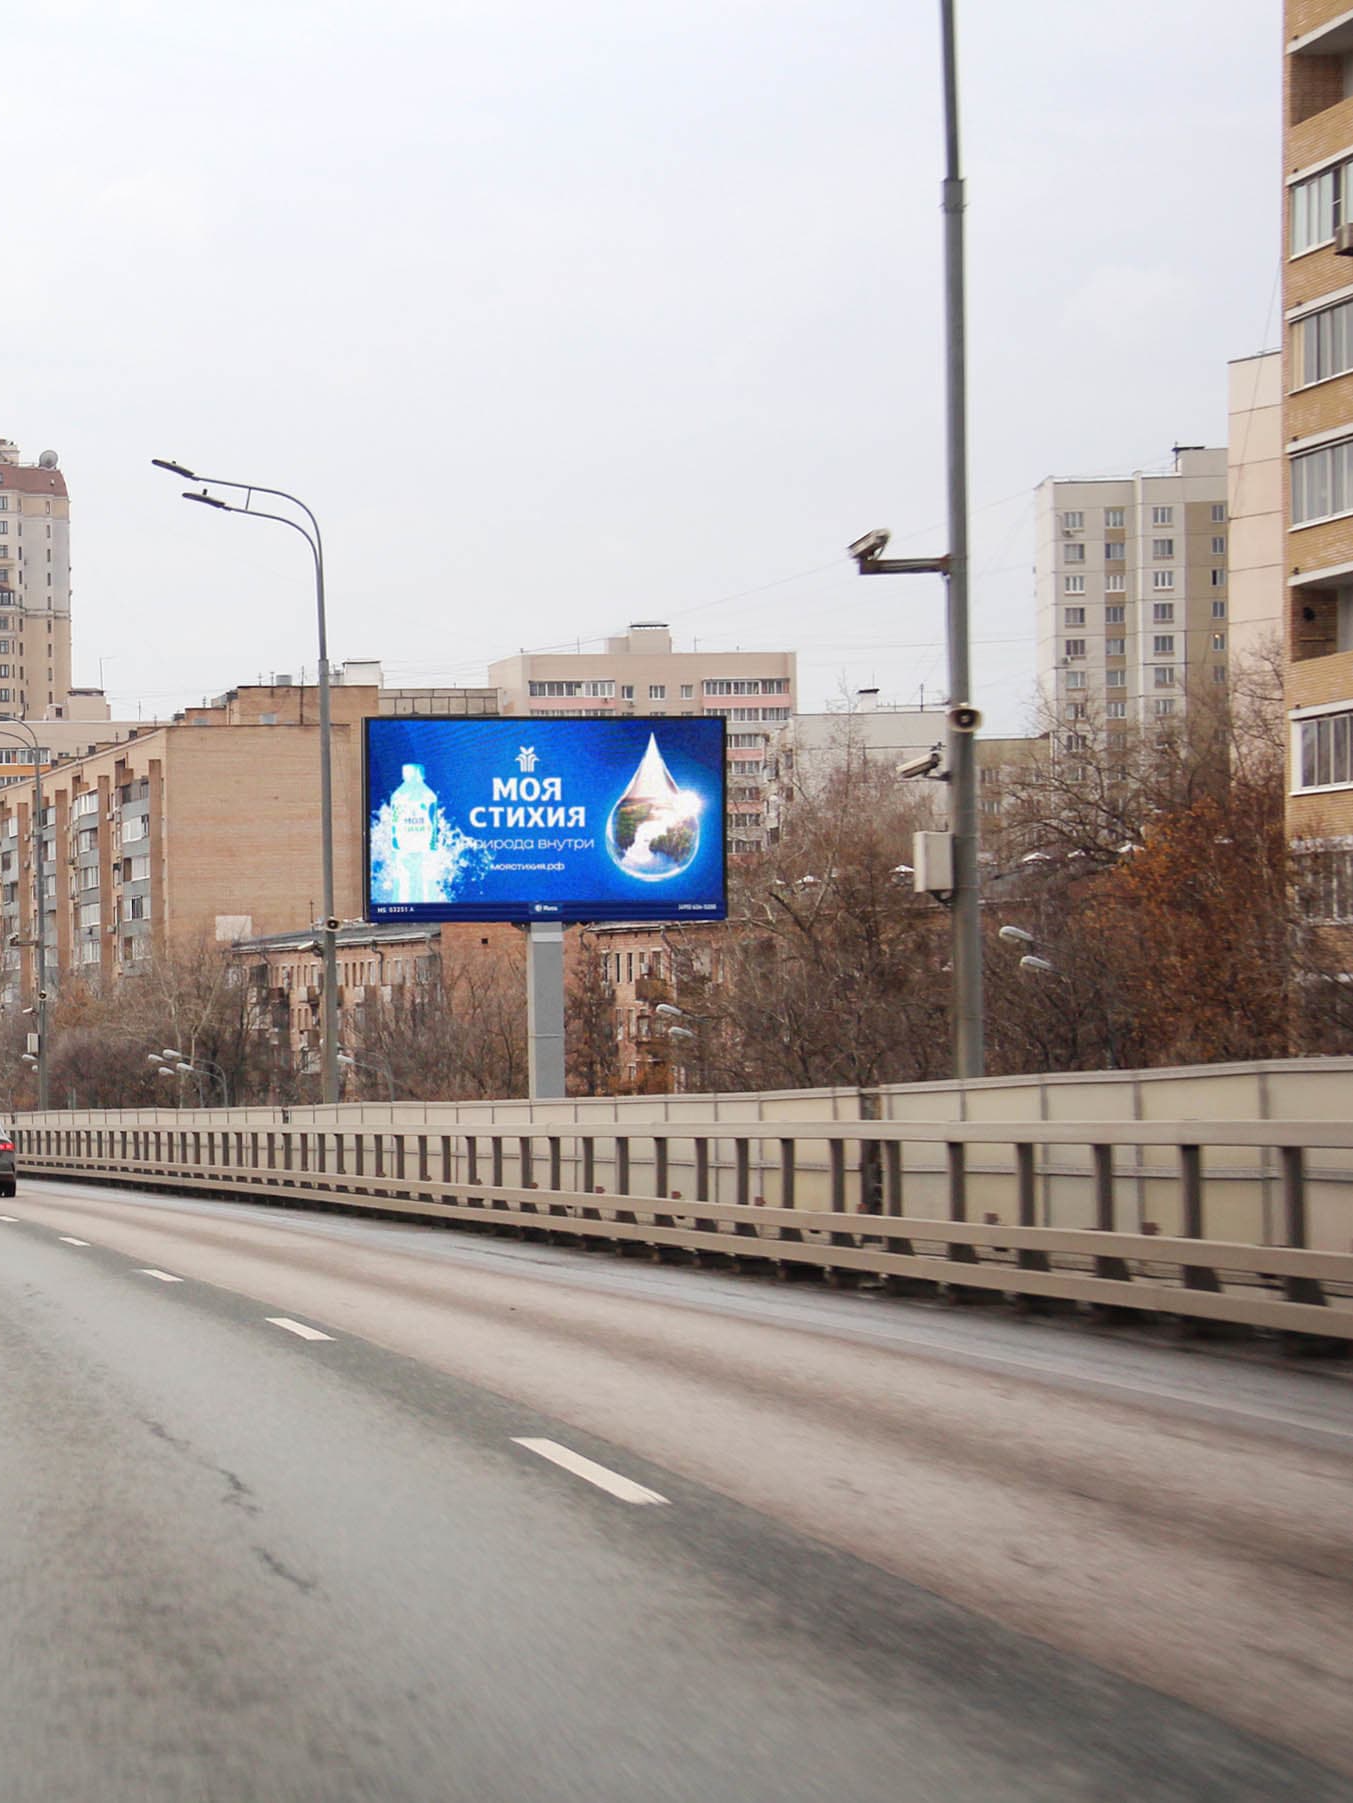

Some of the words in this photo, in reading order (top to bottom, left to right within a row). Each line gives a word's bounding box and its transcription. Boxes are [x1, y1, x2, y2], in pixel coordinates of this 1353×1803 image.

[492, 777, 562, 801] МОЯ
[469, 806, 586, 828] СТИХИЯ
[462, 839, 534, 851] рирода
[537, 839, 595, 851] внутри
